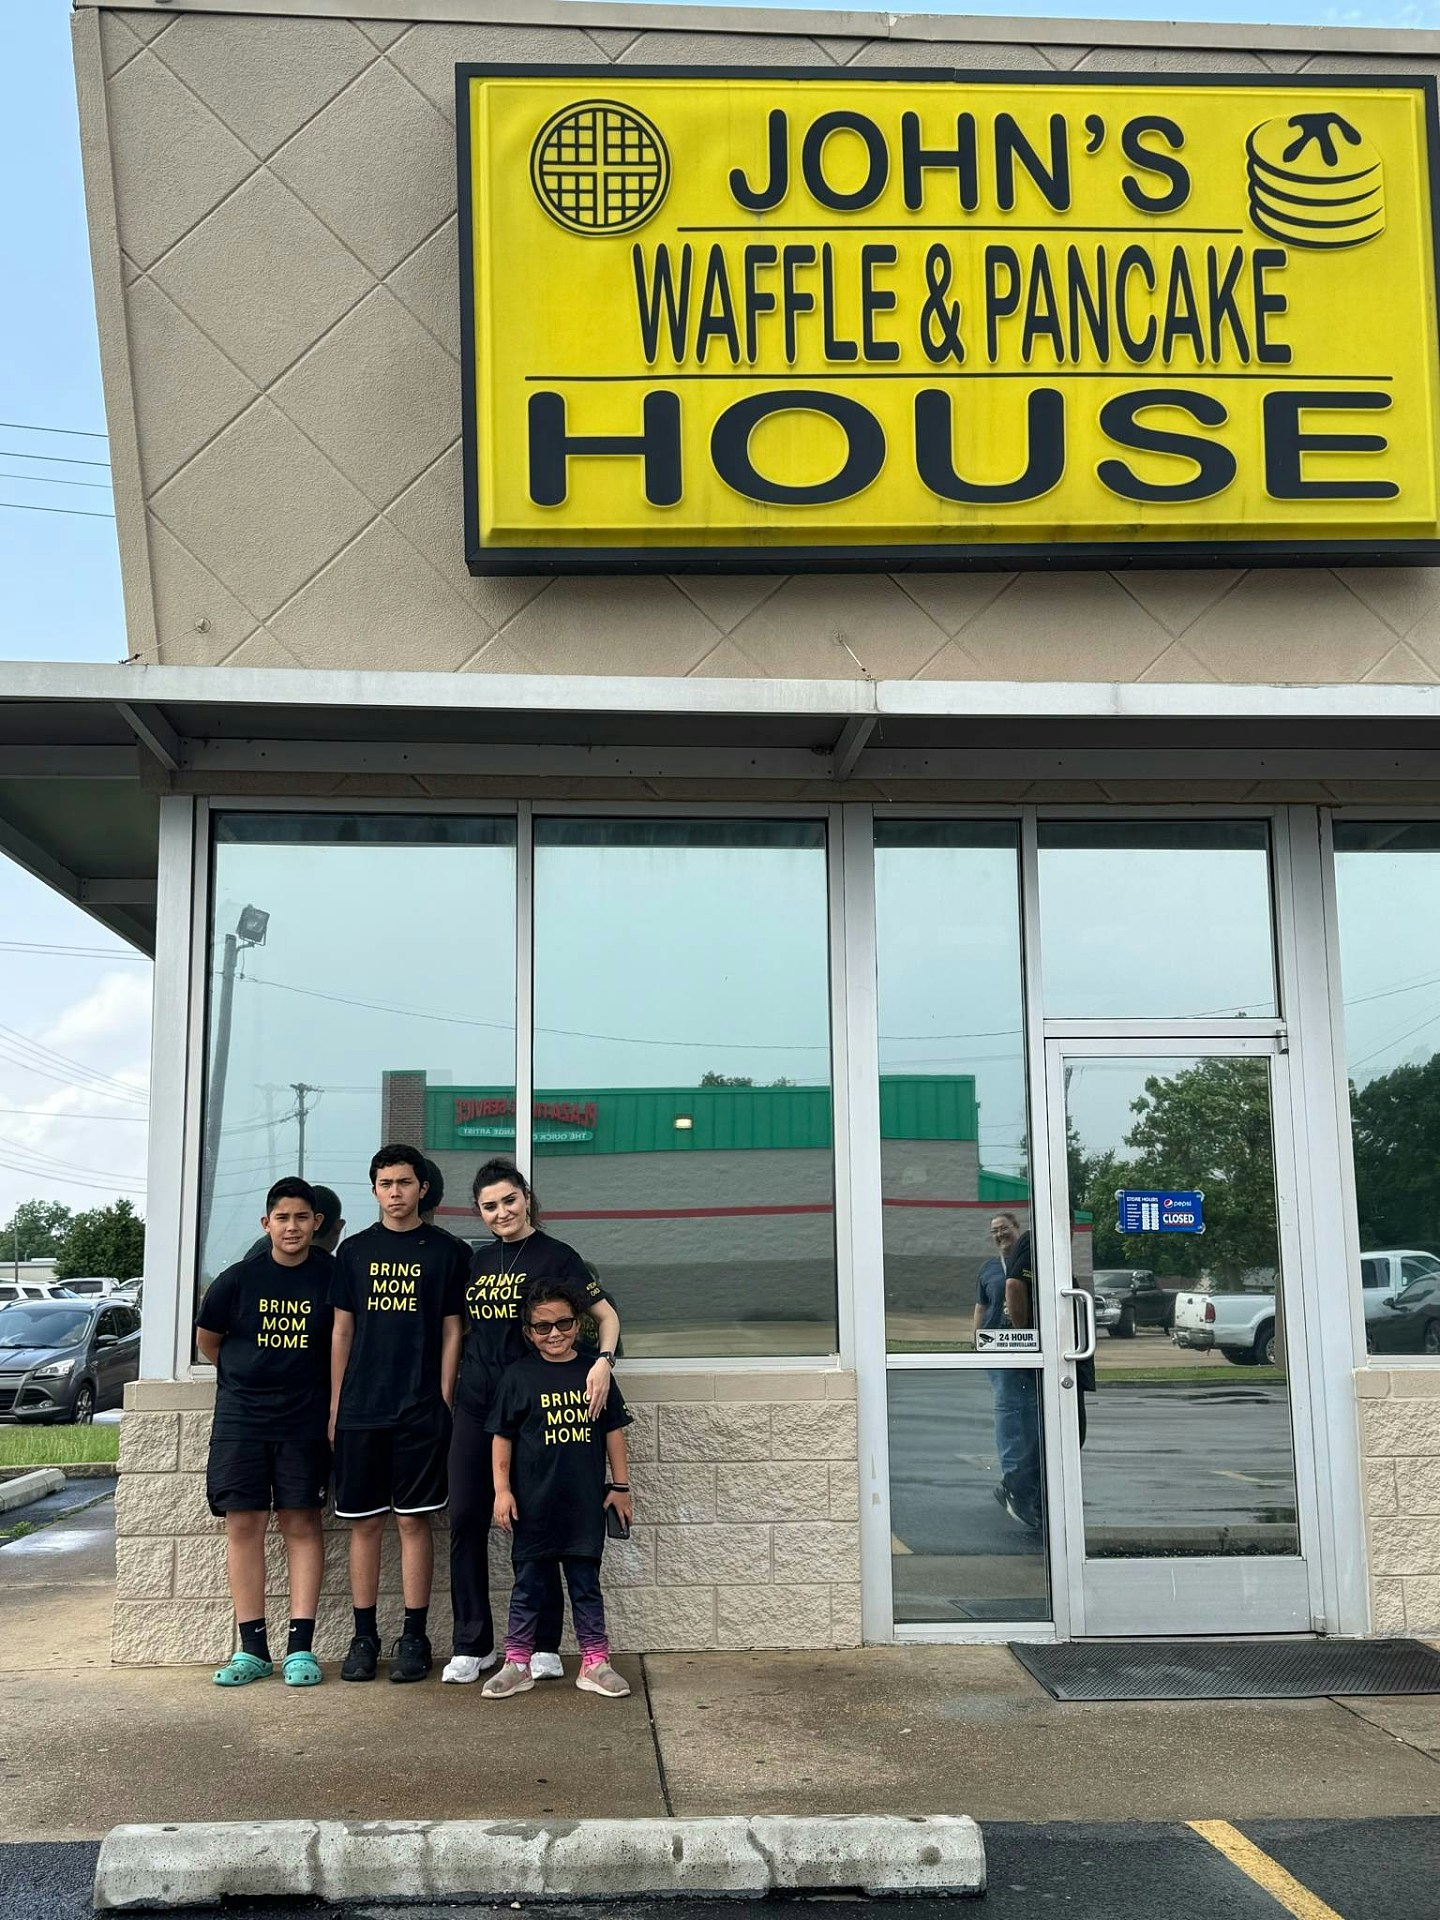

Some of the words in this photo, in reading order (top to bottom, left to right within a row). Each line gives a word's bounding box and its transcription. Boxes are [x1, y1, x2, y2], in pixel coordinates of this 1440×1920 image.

[728, 108, 1192, 216] JOHN'S
[631, 242, 900, 364] WAFFLE
[919, 242, 965, 365] &
[984, 245, 1293, 366] PANCAKE
[527, 387, 1400, 507] HOUSE
[1162, 1213, 1195, 1224] CLOSED
[369, 1262, 421, 1277] BRING
[372, 1279, 415, 1294] MOM
[475, 1273, 527, 1287] BRING
[466, 1285, 523, 1301] CAROL
[259, 1298, 312, 1315] BRING
[367, 1296, 418, 1312] HOME
[468, 1303, 518, 1320] HOME
[262, 1316, 306, 1331] MOM
[257, 1333, 309, 1349] HOME
[998, 1333, 1010, 1341] 24
[1011, 1333, 1034, 1341] HOUR
[547, 1408, 589, 1425] MOM
[544, 1427, 592, 1445] HOME
